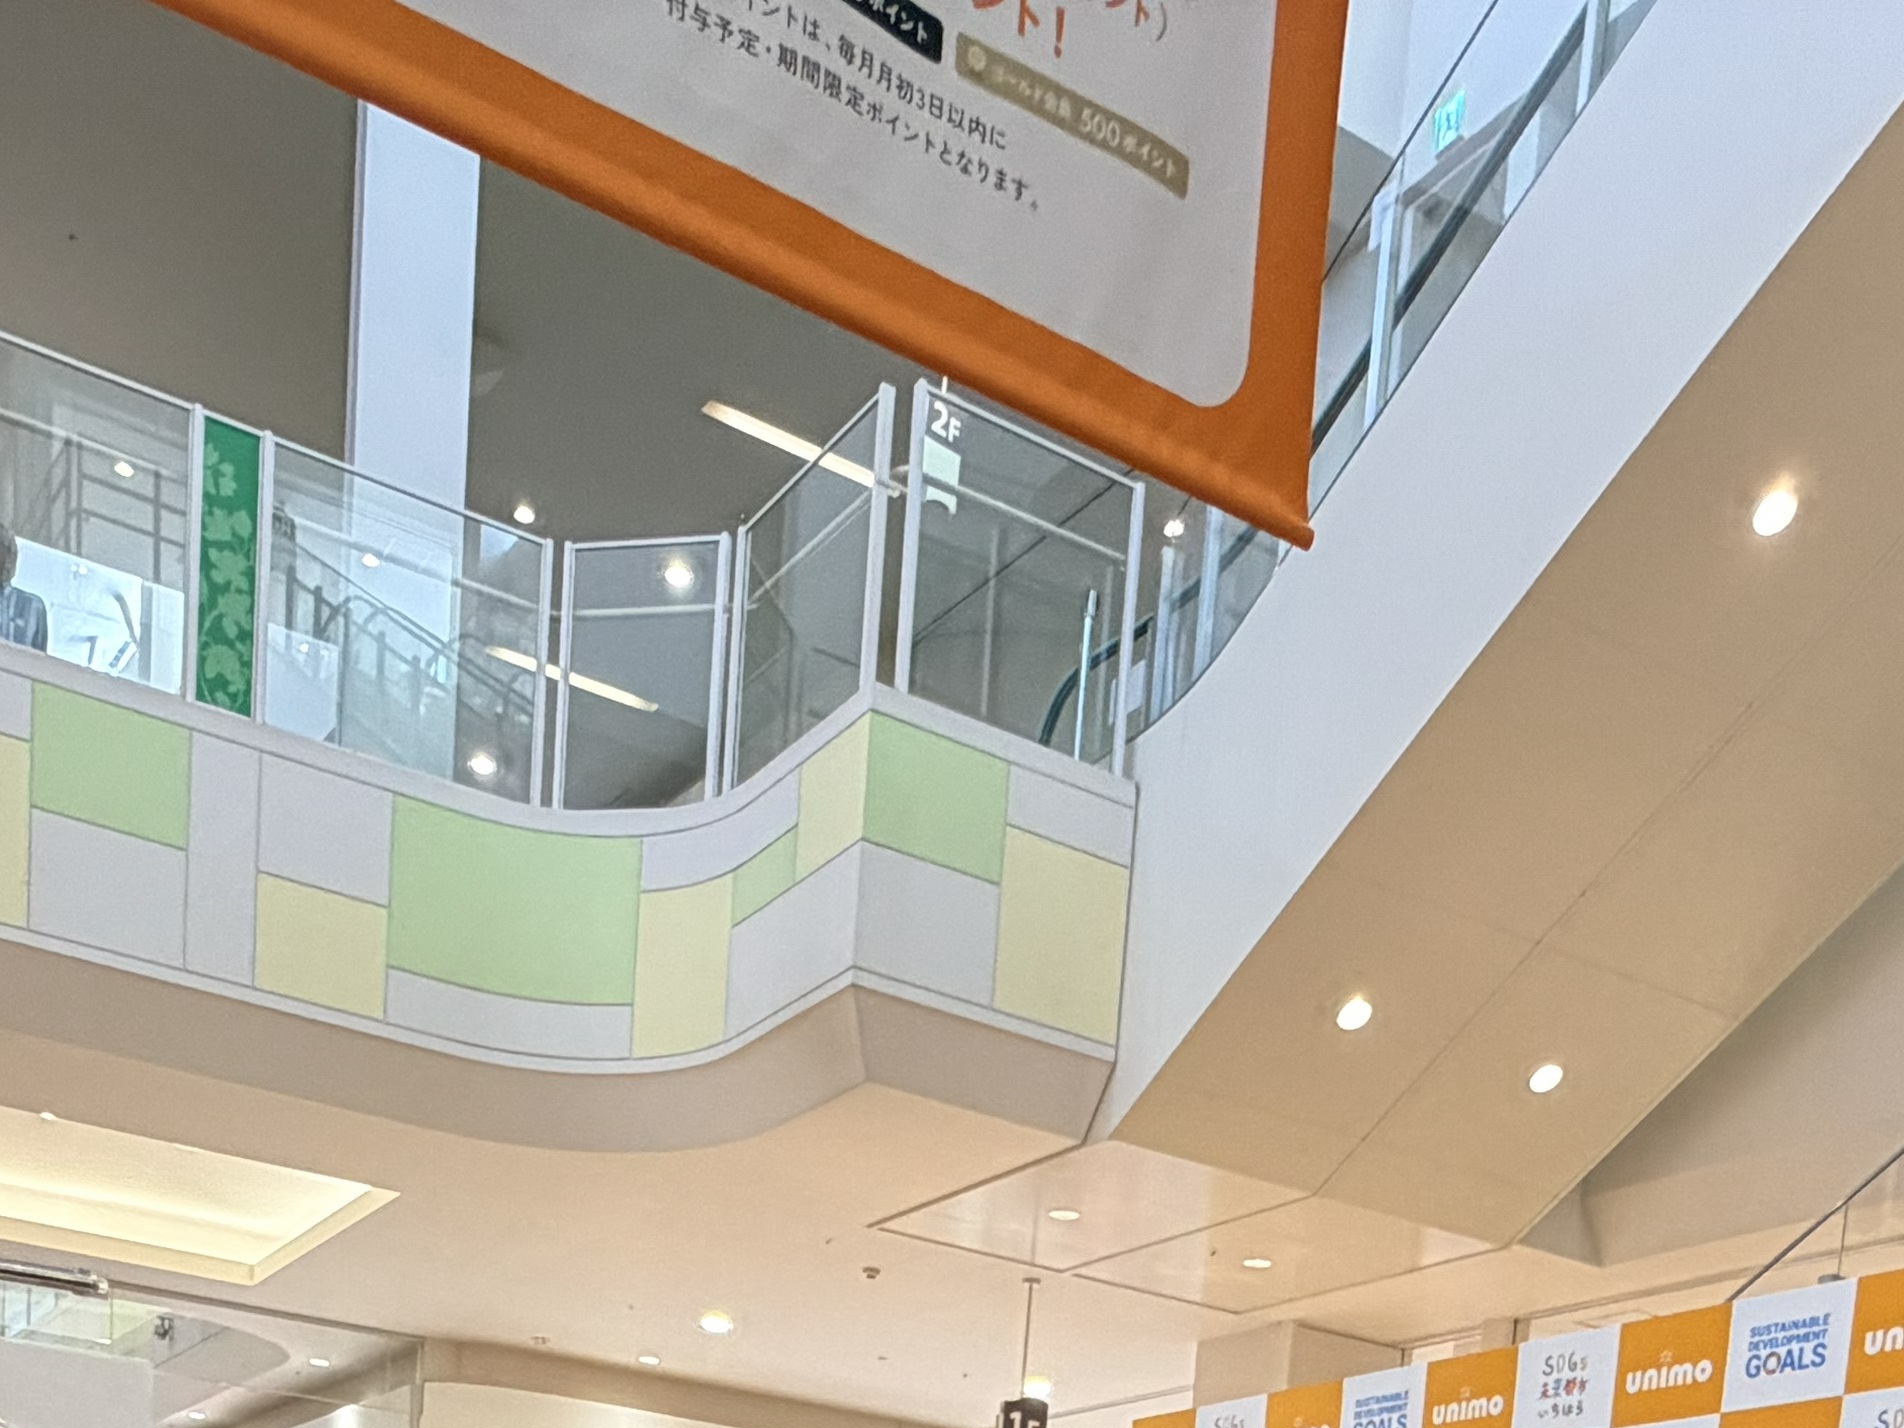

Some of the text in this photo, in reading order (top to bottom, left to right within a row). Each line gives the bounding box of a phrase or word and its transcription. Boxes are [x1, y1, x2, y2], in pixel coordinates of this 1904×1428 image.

[931, 401, 961, 443] 2F
[1748, 1328, 1828, 1352] DEVELOPMENT
[1749, 1313, 1831, 1338] SUSTAINABLE
[1625, 1359, 1713, 1394] unimo
[1745, 1343, 1828, 1378] GOALS
[1432, 1394, 1504, 1425] unimo
